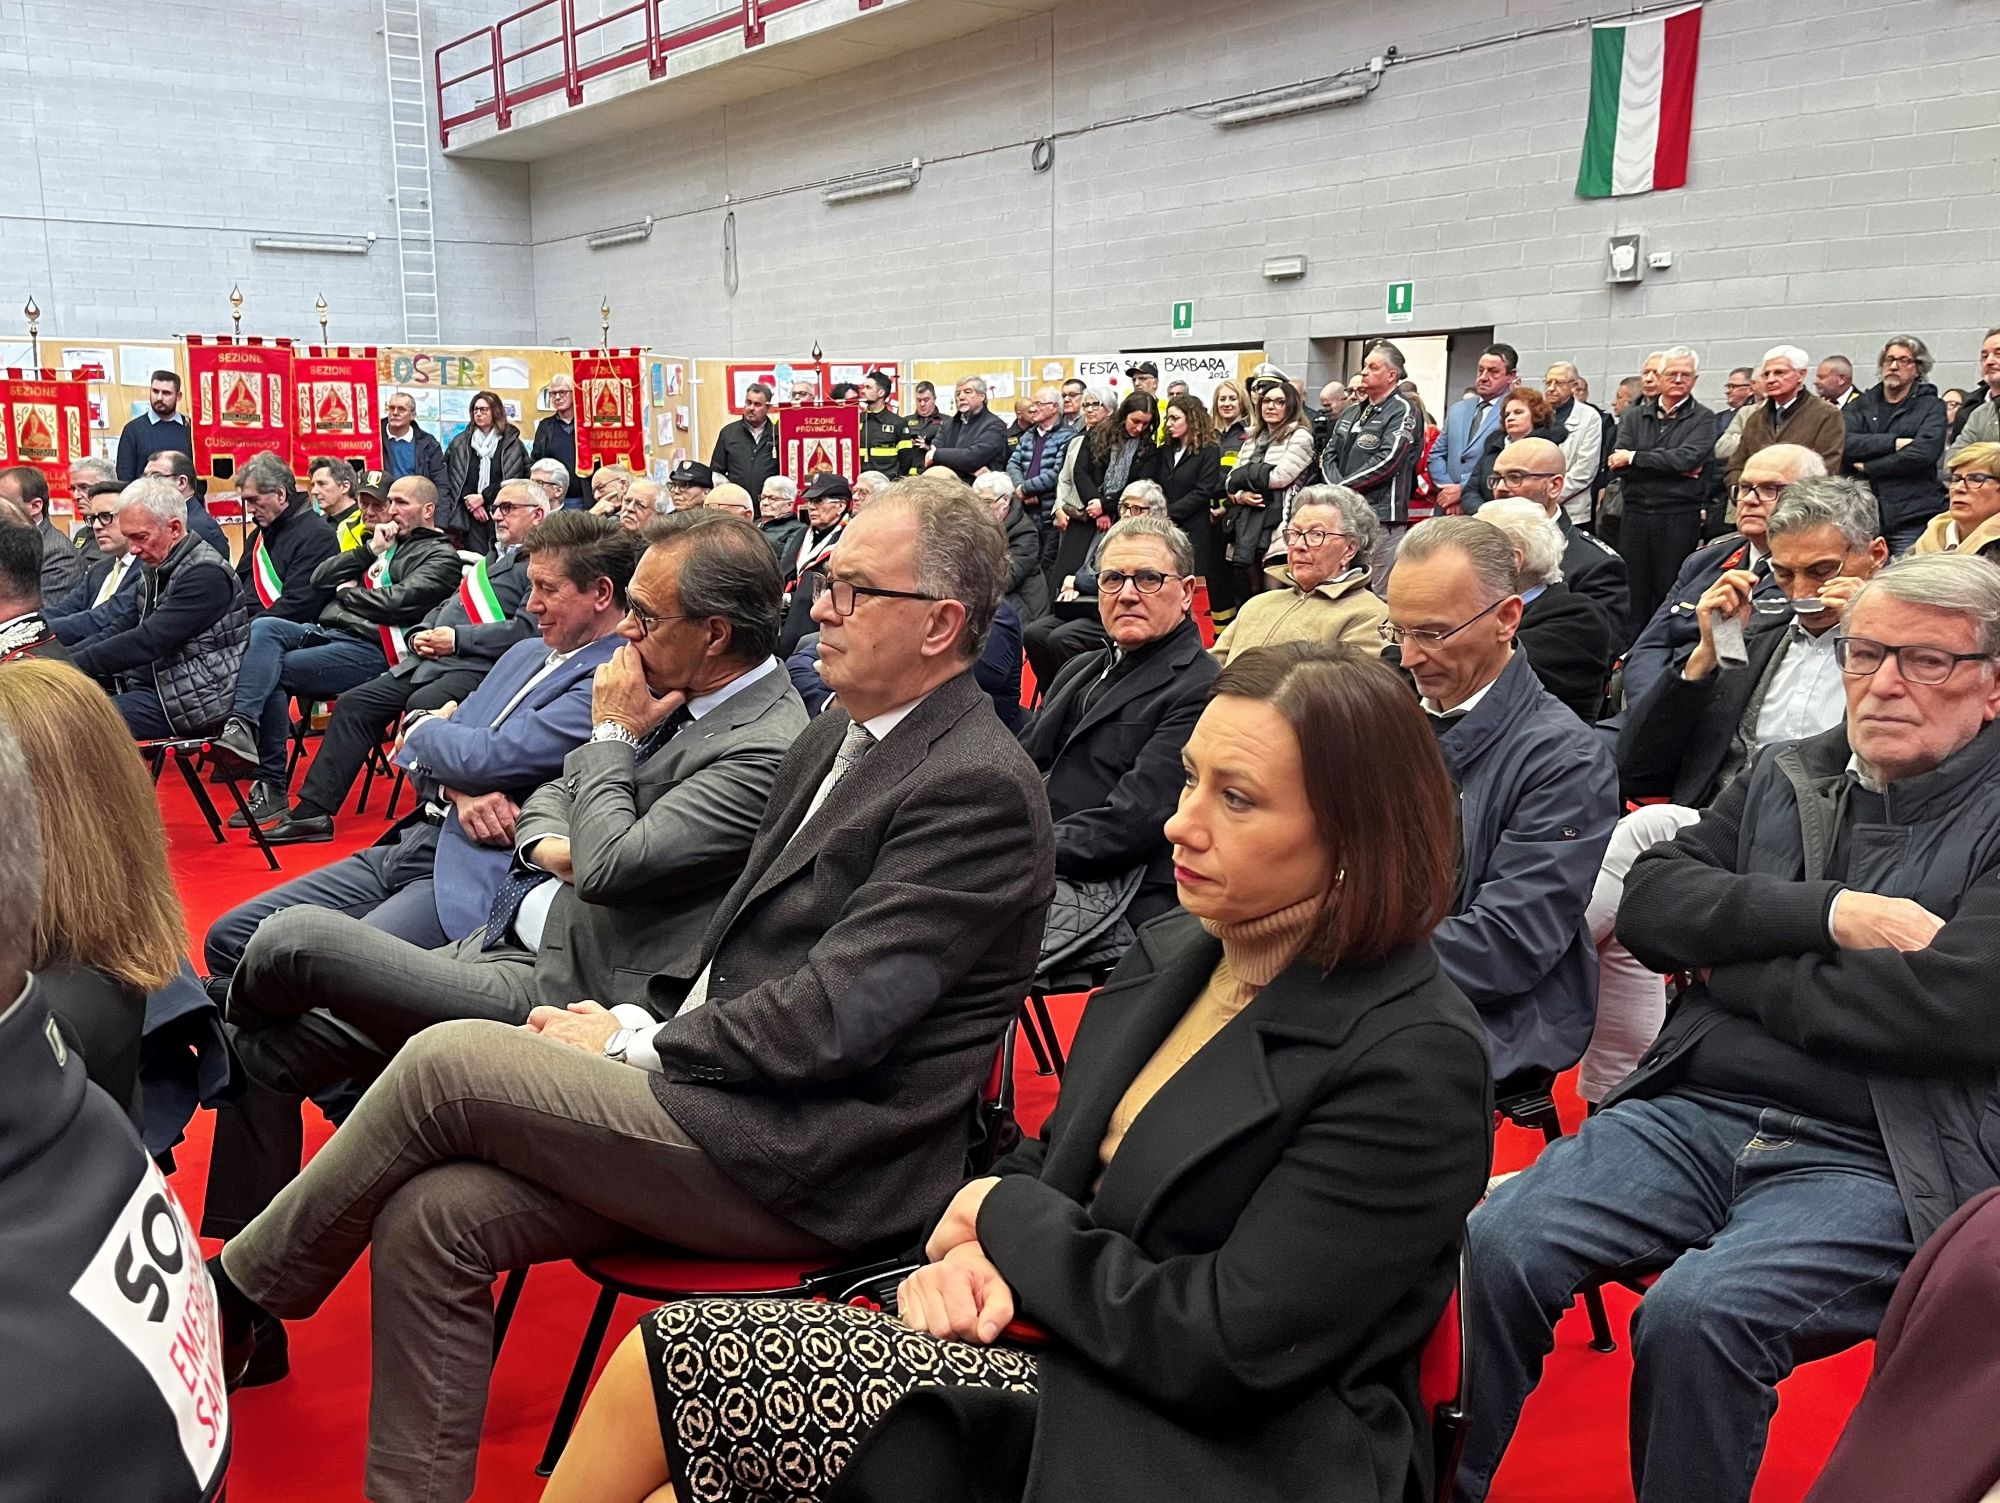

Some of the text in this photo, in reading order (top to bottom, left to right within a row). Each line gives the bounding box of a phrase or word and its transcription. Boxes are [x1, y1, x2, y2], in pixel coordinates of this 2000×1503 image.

[218, 353, 263, 363] SEZIONE
[310, 366, 352, 376] SEZIONE
[1080, 361, 1120, 376] FESTA
[1164, 357, 1226, 373] BARBARA
[1208, 371, 1230, 379] 2025
[9, 385, 58, 397] SEZIONE
[804, 417, 836, 425] SEZIONE
[796, 425, 844, 433] PROVINCIALE
